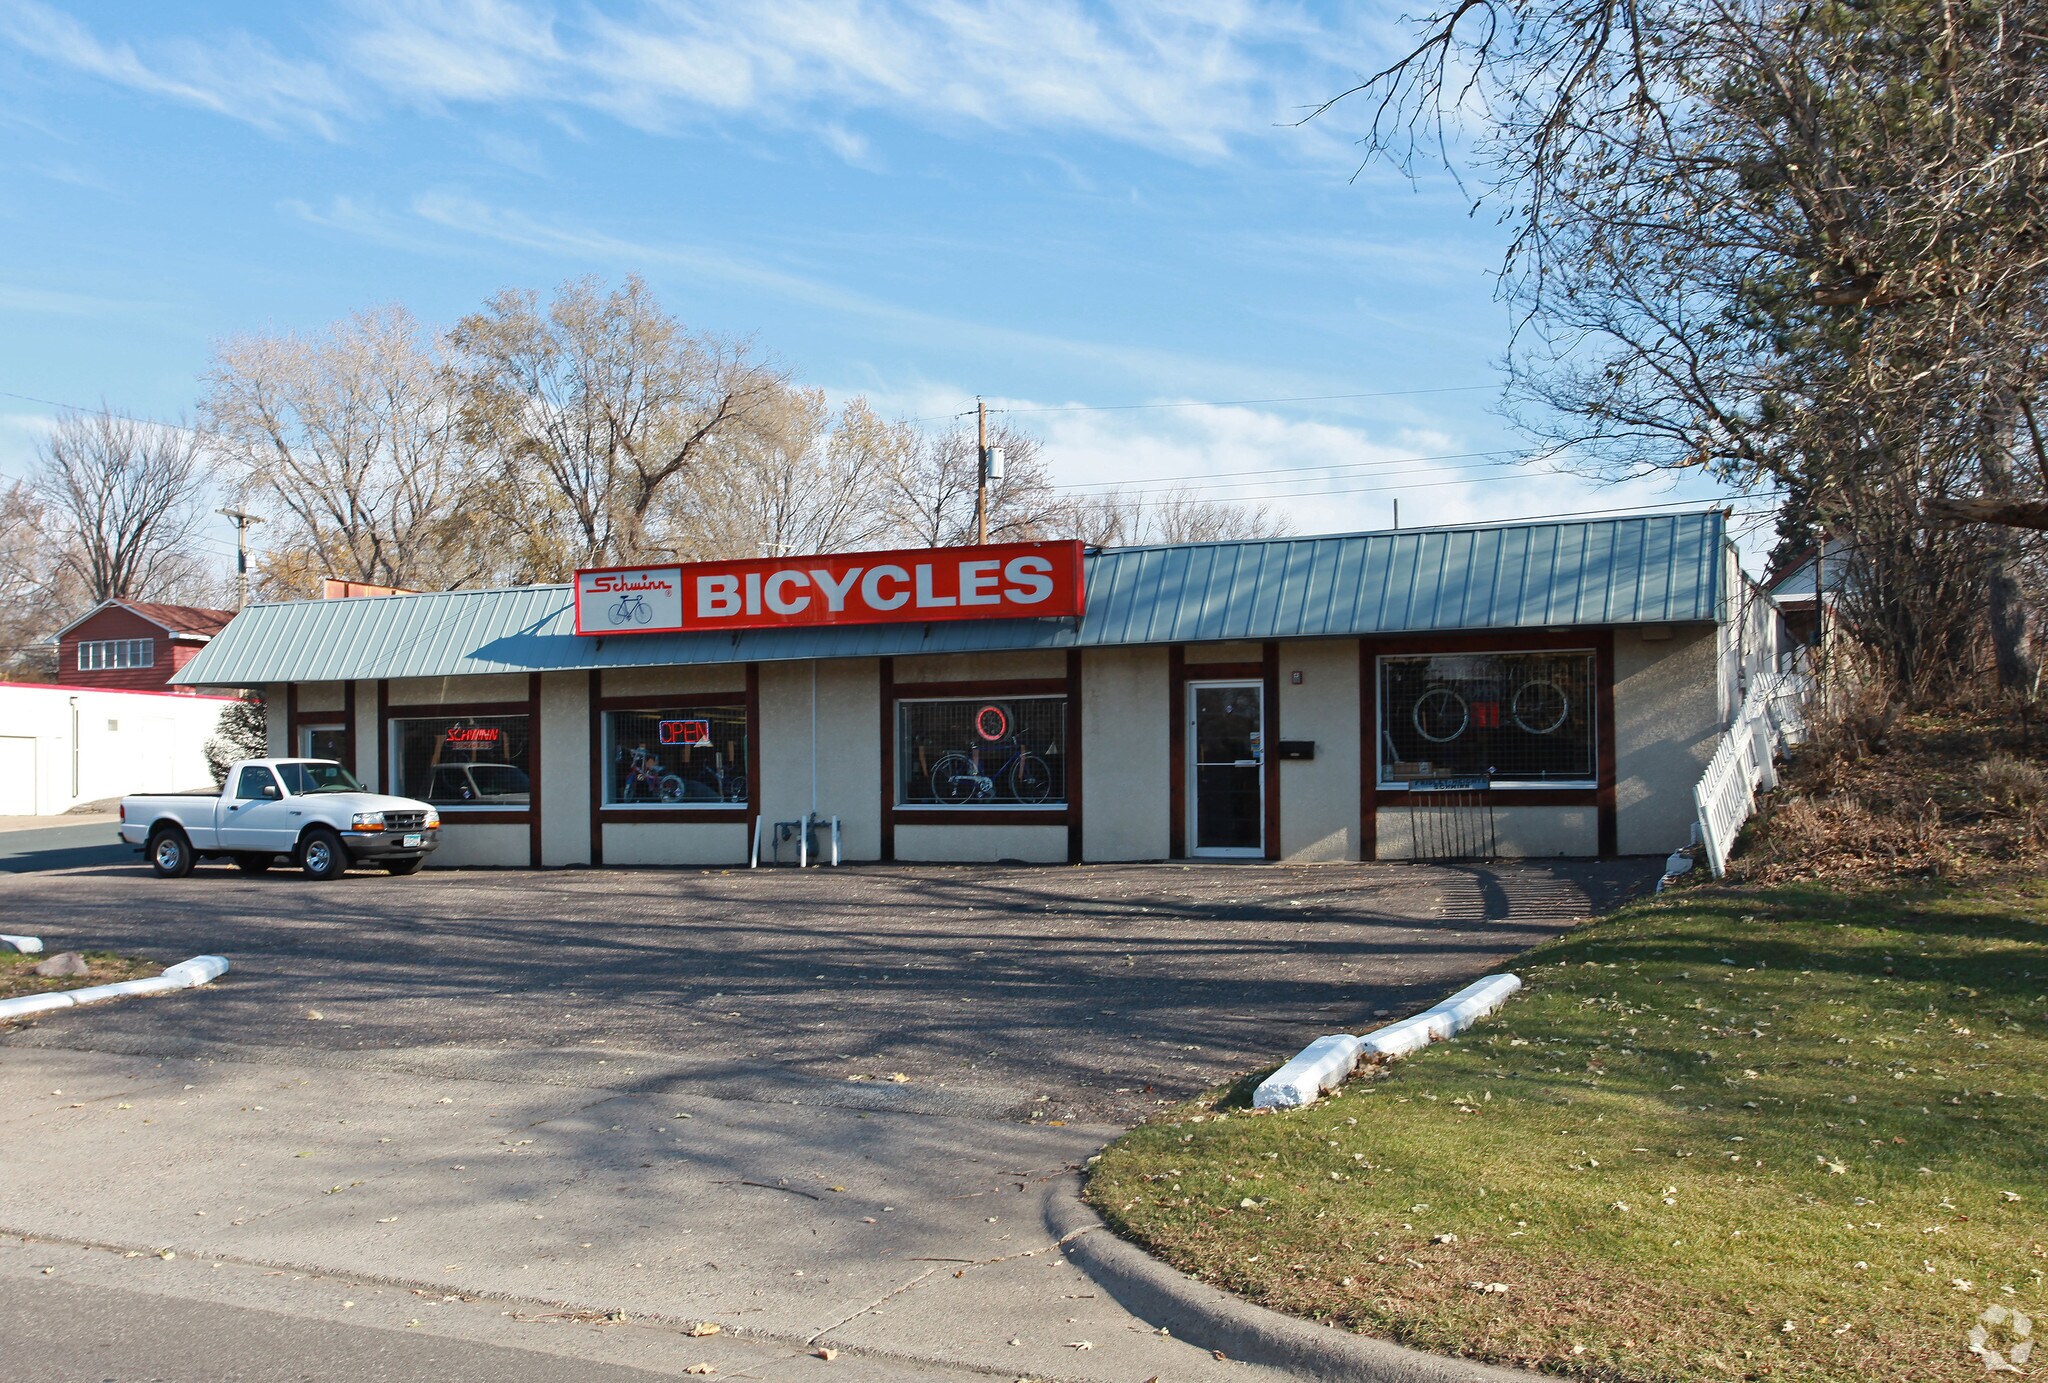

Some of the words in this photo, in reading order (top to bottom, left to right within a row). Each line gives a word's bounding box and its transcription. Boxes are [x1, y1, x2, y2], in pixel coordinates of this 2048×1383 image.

[586, 574, 672, 593] Schwinn
[697, 555, 1054, 618] BICYCLES
[447, 728, 499, 741] SCHWINN
[661, 721, 709, 743] OPEN
